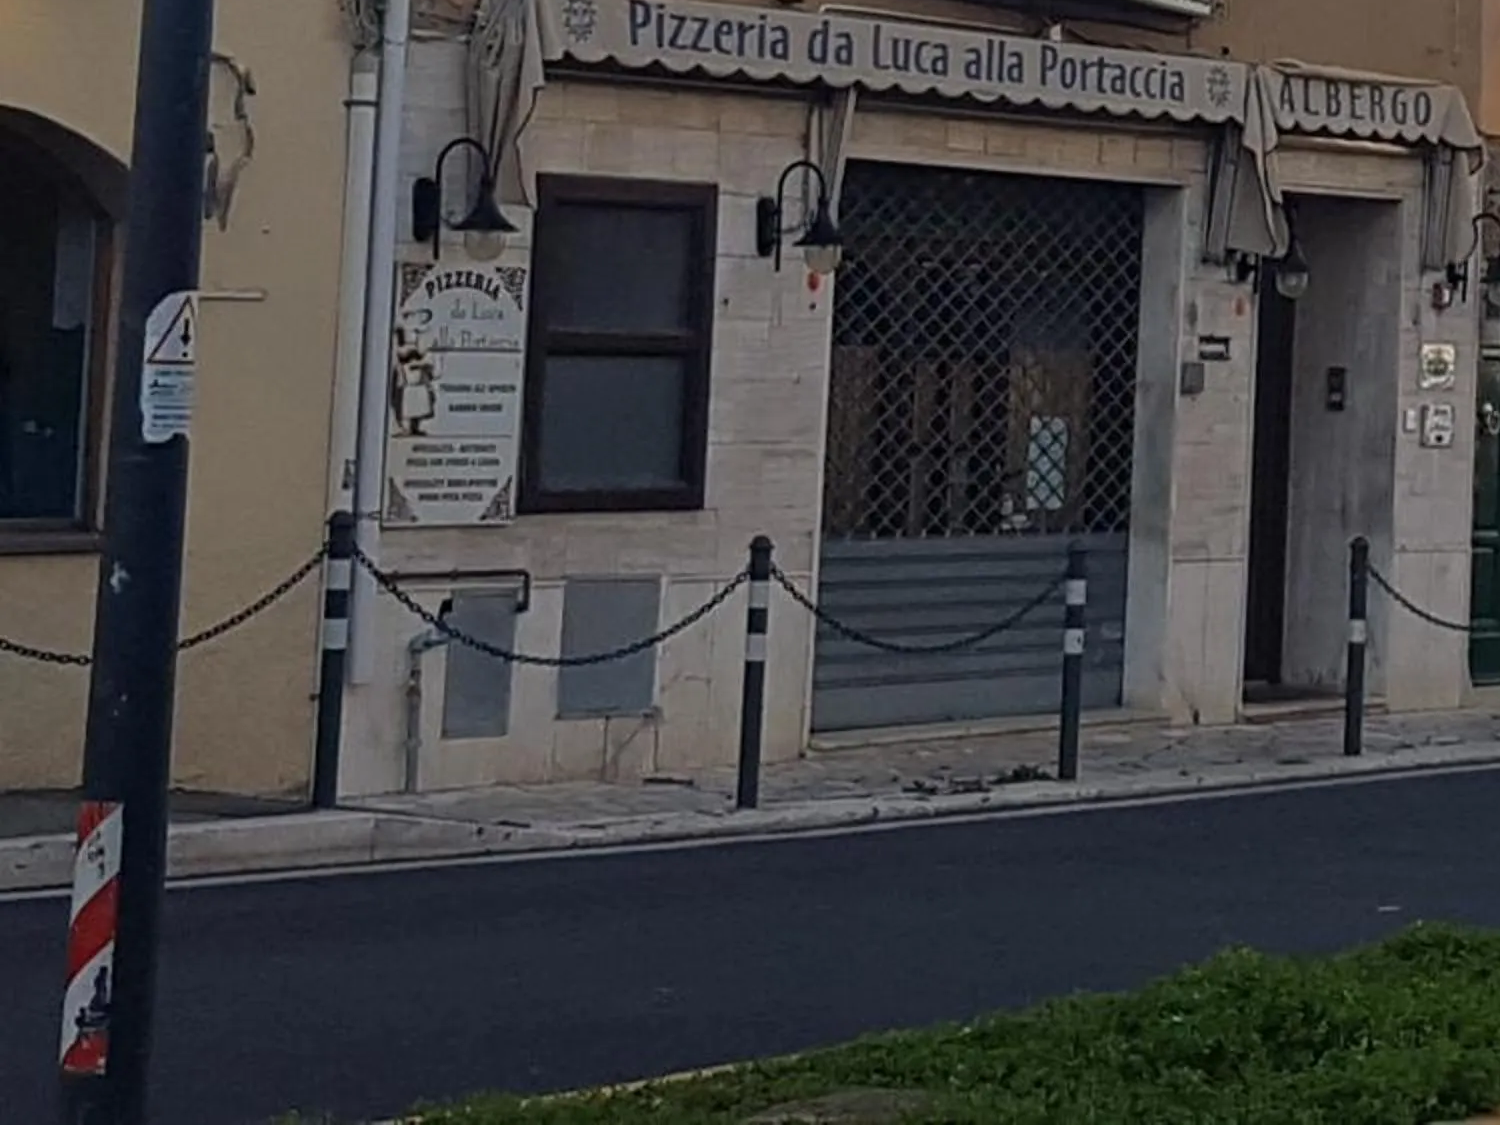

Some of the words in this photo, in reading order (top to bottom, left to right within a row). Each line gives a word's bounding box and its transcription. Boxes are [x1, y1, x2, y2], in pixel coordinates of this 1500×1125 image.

[807, 19, 853, 67] da
[872, 24, 950, 78] Luca
[964, 39, 1024, 84] alla
[1038, 44, 1186, 104] Portaccia
[1278, 73, 1432, 129] ALBERGO
[425, 270, 500, 300] PIZZERIA
